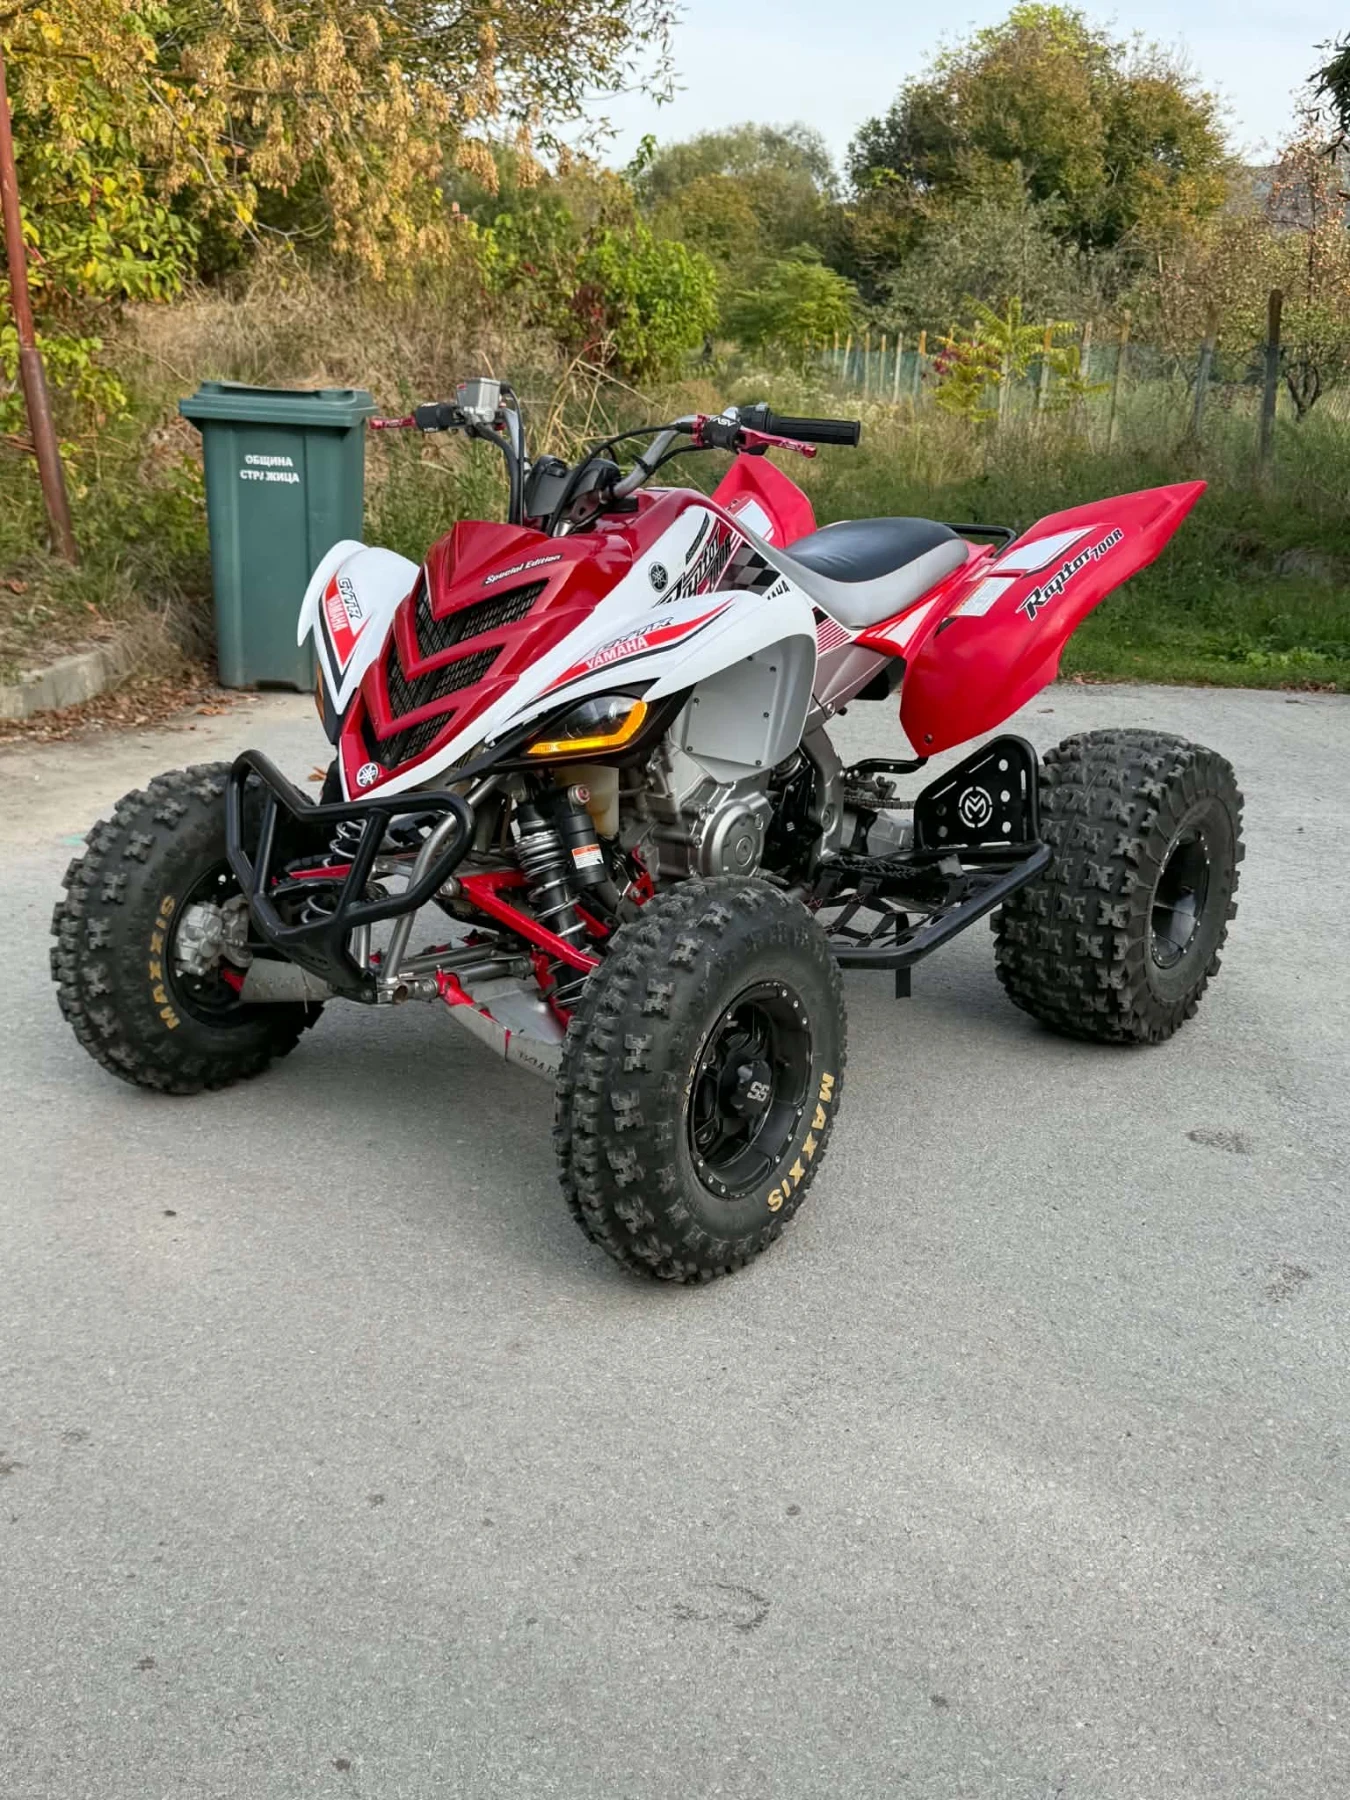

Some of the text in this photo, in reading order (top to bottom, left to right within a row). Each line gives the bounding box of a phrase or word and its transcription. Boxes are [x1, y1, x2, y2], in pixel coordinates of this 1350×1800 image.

[245, 454, 293, 467] ОБЩИНА
[484, 554, 562, 585] Special Edition
[1015, 546, 1092, 621] Raptor
[1090, 527, 1124, 562] 700R
[339, 577, 363, 619] GYTR
[586, 636, 650, 669] YAMAHA
[148, 895, 181, 1030] MAXXIS
[768, 1072, 835, 1212] MAXXIS
